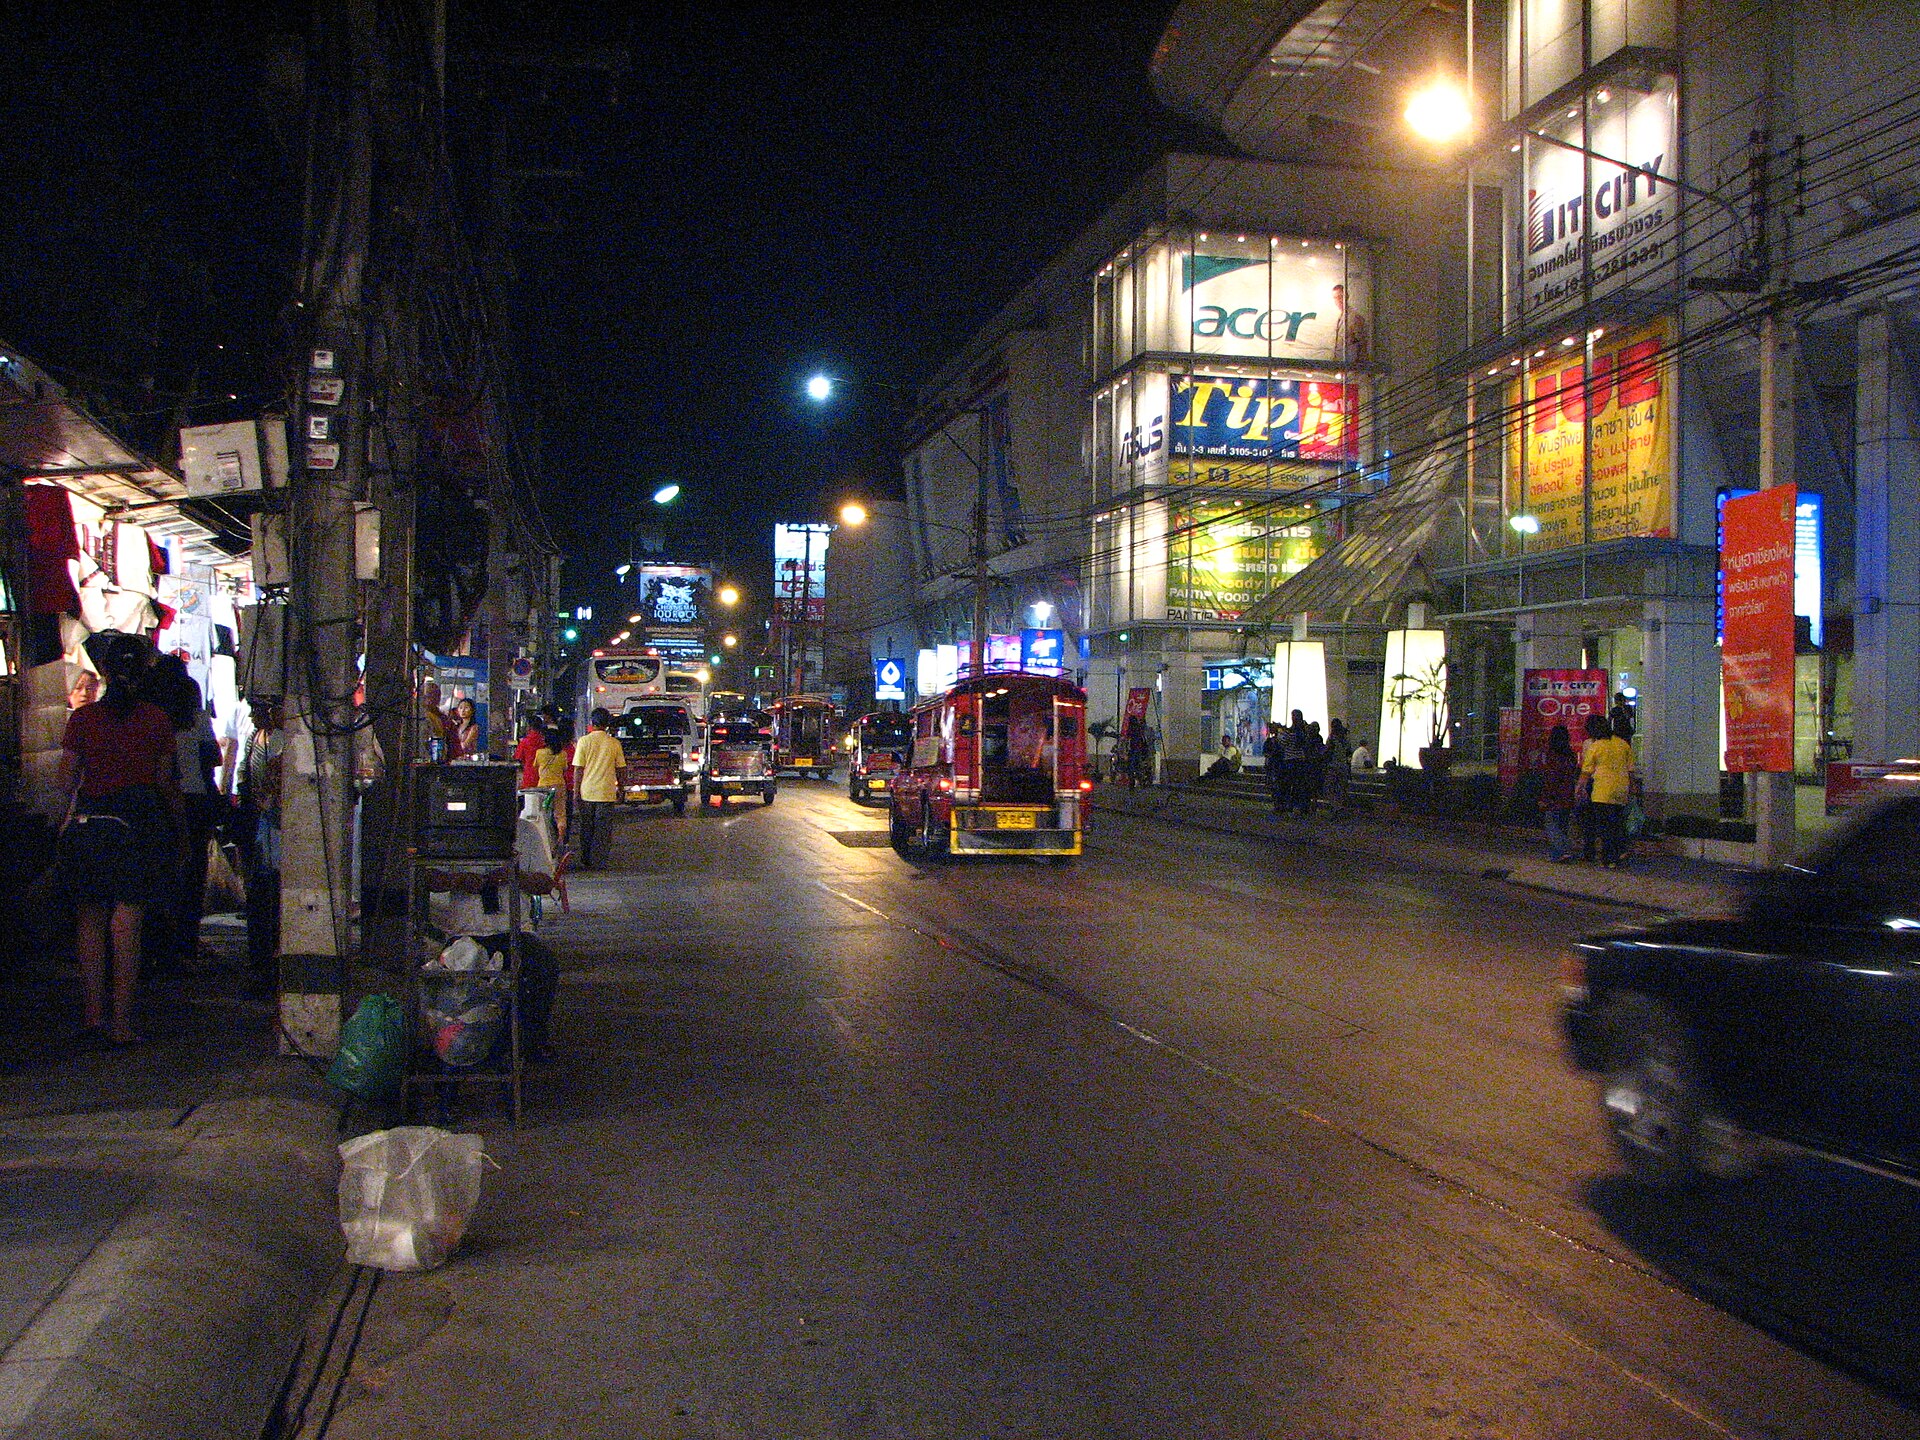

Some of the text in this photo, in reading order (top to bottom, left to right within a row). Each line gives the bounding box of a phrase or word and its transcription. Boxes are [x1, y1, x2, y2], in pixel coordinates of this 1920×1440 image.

[1558, 154, 1664, 239] IT CITY
[1194, 304, 1317, 343] acer
[1175, 381, 1299, 441] Tip
[1645, 404, 1655, 424] 4
[1119, 414, 1164, 468] ASUS
[1217, 591, 1250, 602] FOOD
[672, 610, 698, 619] ROCK
[1569, 682, 1597, 690] CITY
[1537, 697, 1591, 716] One
